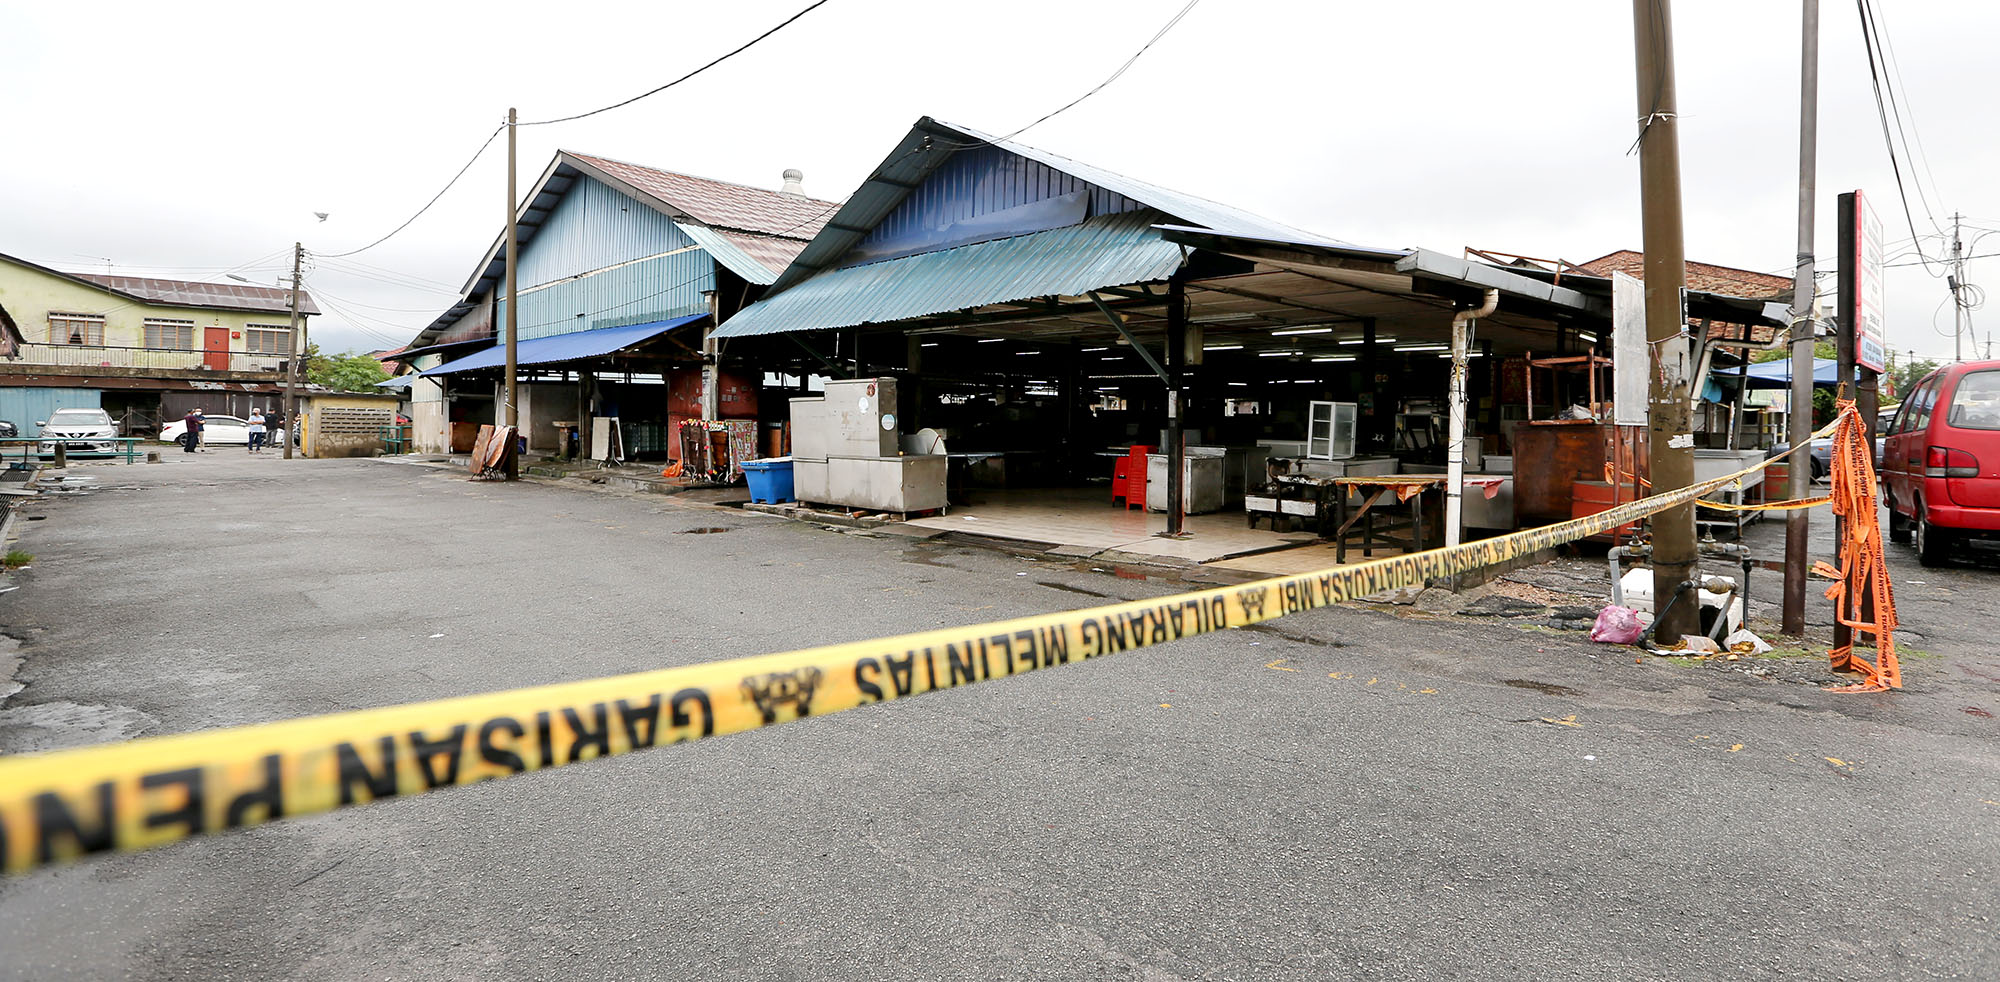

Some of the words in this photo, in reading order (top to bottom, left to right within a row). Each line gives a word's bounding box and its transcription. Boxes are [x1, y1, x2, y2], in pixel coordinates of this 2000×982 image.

[1319, 554, 1439, 608] PENGUATKUASA
[1443, 542, 1491, 576] GARISAN
[1279, 578, 1314, 615] MBI
[1081, 595, 1226, 659] DILARANG
[854, 623, 1067, 703] MELINTAS
[336, 687, 713, 804] GARISAN
